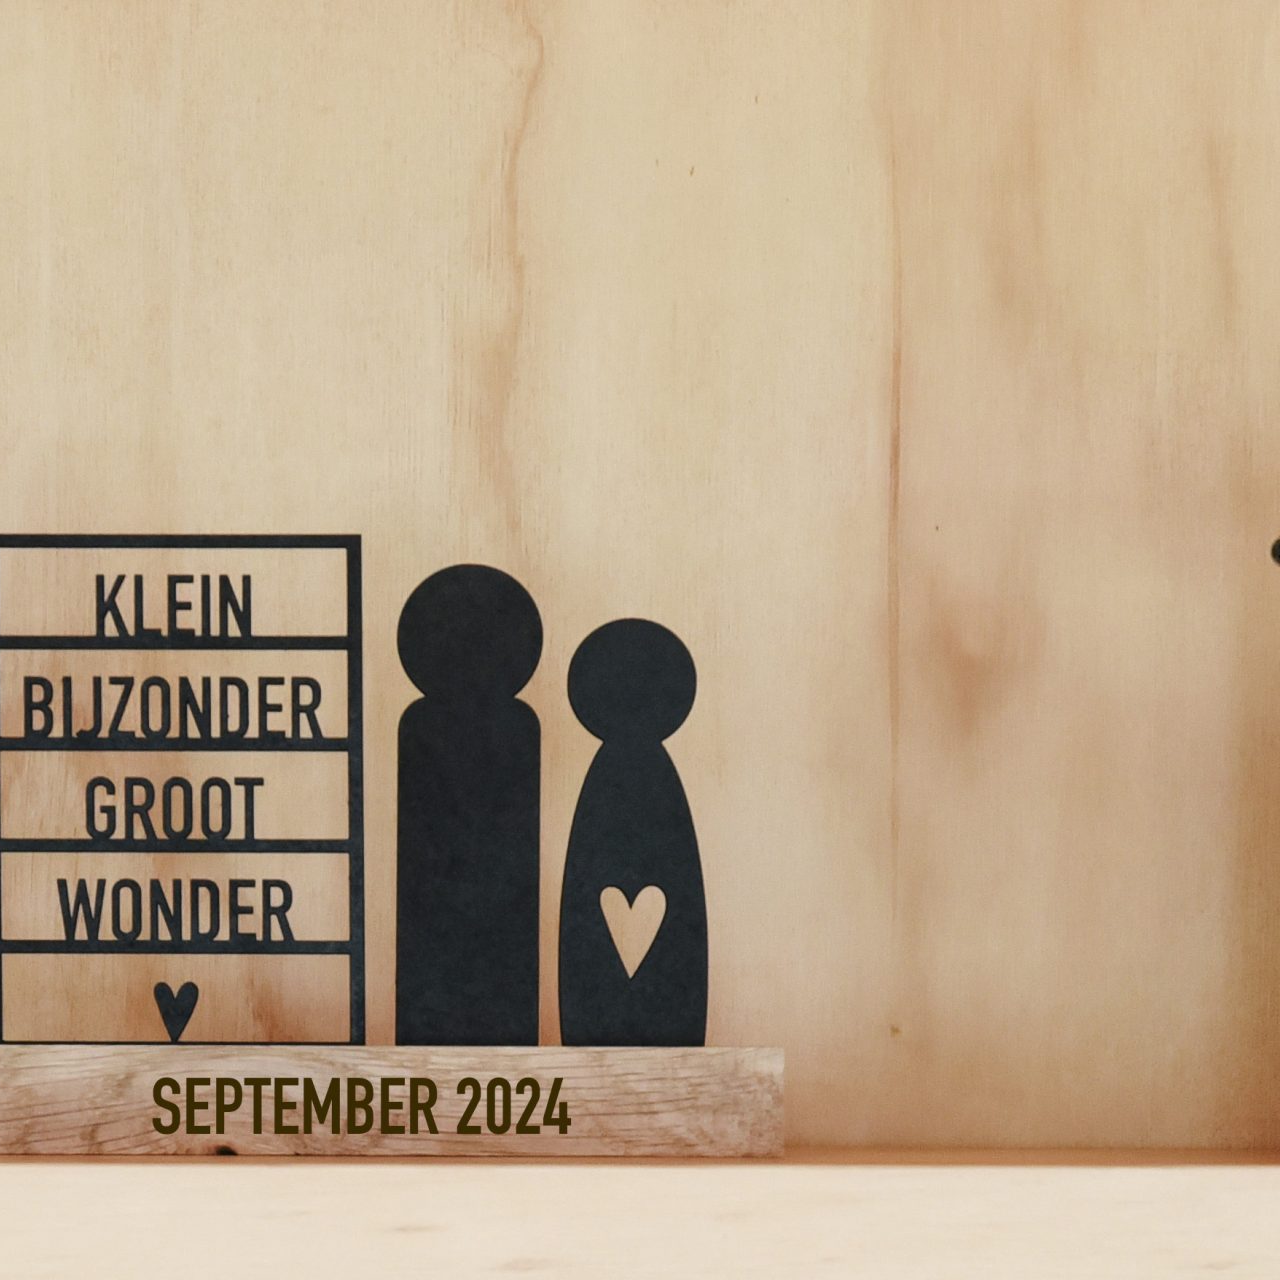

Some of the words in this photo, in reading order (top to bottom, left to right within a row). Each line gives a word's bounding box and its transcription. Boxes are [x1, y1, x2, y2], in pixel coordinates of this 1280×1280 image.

[95, 574, 252, 638] KLEIN
[23, 676, 324, 739] BIJZONDER
[85, 776, 264, 840] GROOT
[56, 878, 295, 942] WONDER
[151, 1076, 438, 1135] SEPTEMBER
[455, 1076, 572, 1135] 2024
